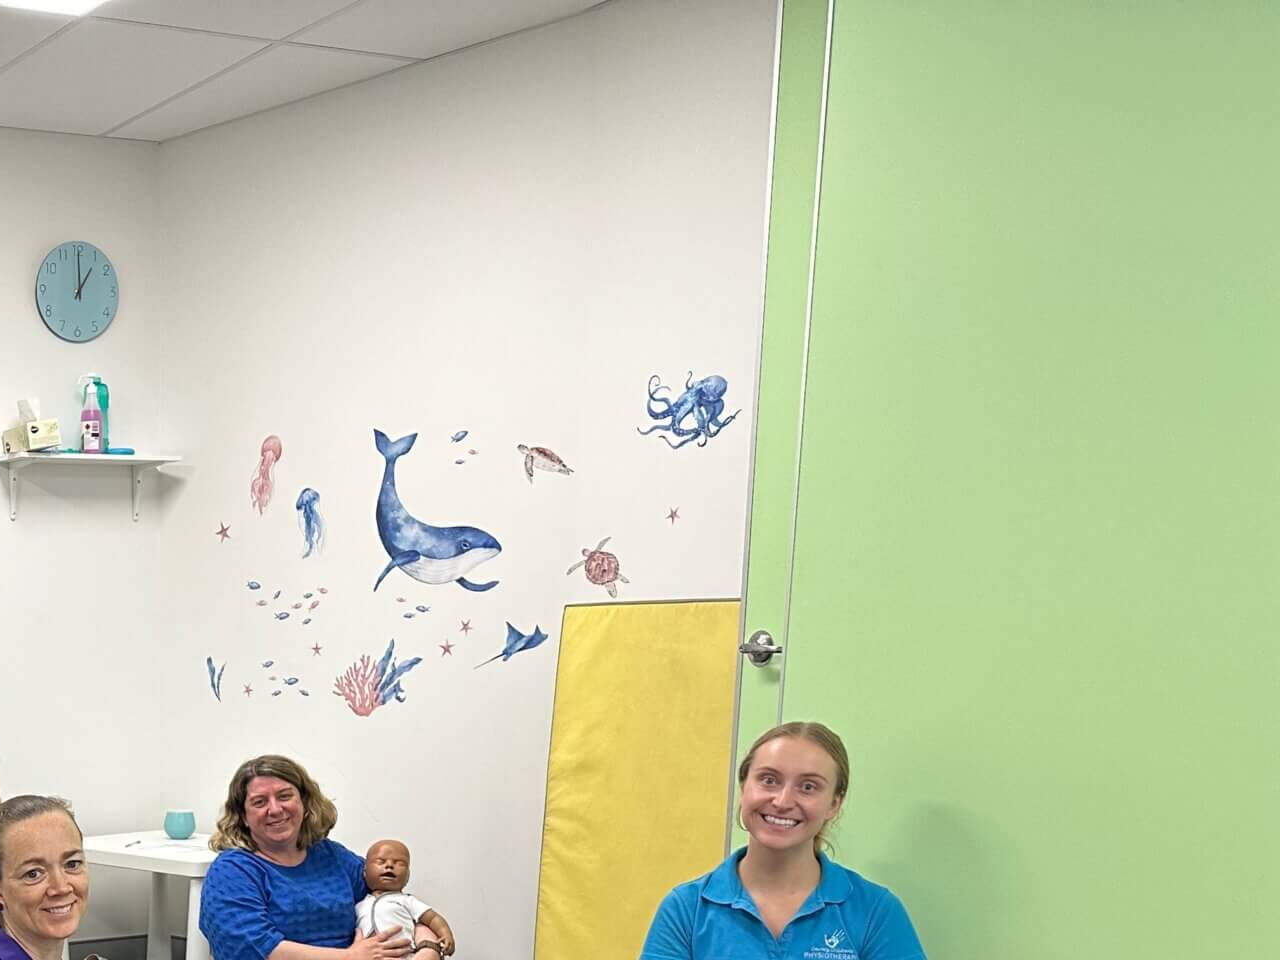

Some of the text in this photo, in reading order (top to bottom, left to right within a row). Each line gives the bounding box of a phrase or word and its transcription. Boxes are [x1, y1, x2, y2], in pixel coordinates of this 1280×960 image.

[58, 249, 68, 261] 11
[72, 245, 84, 256] 12
[45, 262, 57, 274] 10
[102, 264, 110, 276] 2
[40, 284, 47, 296] 9
[45, 304, 52, 317] 8
[102, 307, 110, 318] 4
[59, 319, 66, 332] 7
[91, 320, 98, 333] 5
[74, 326, 81, 338] 6
